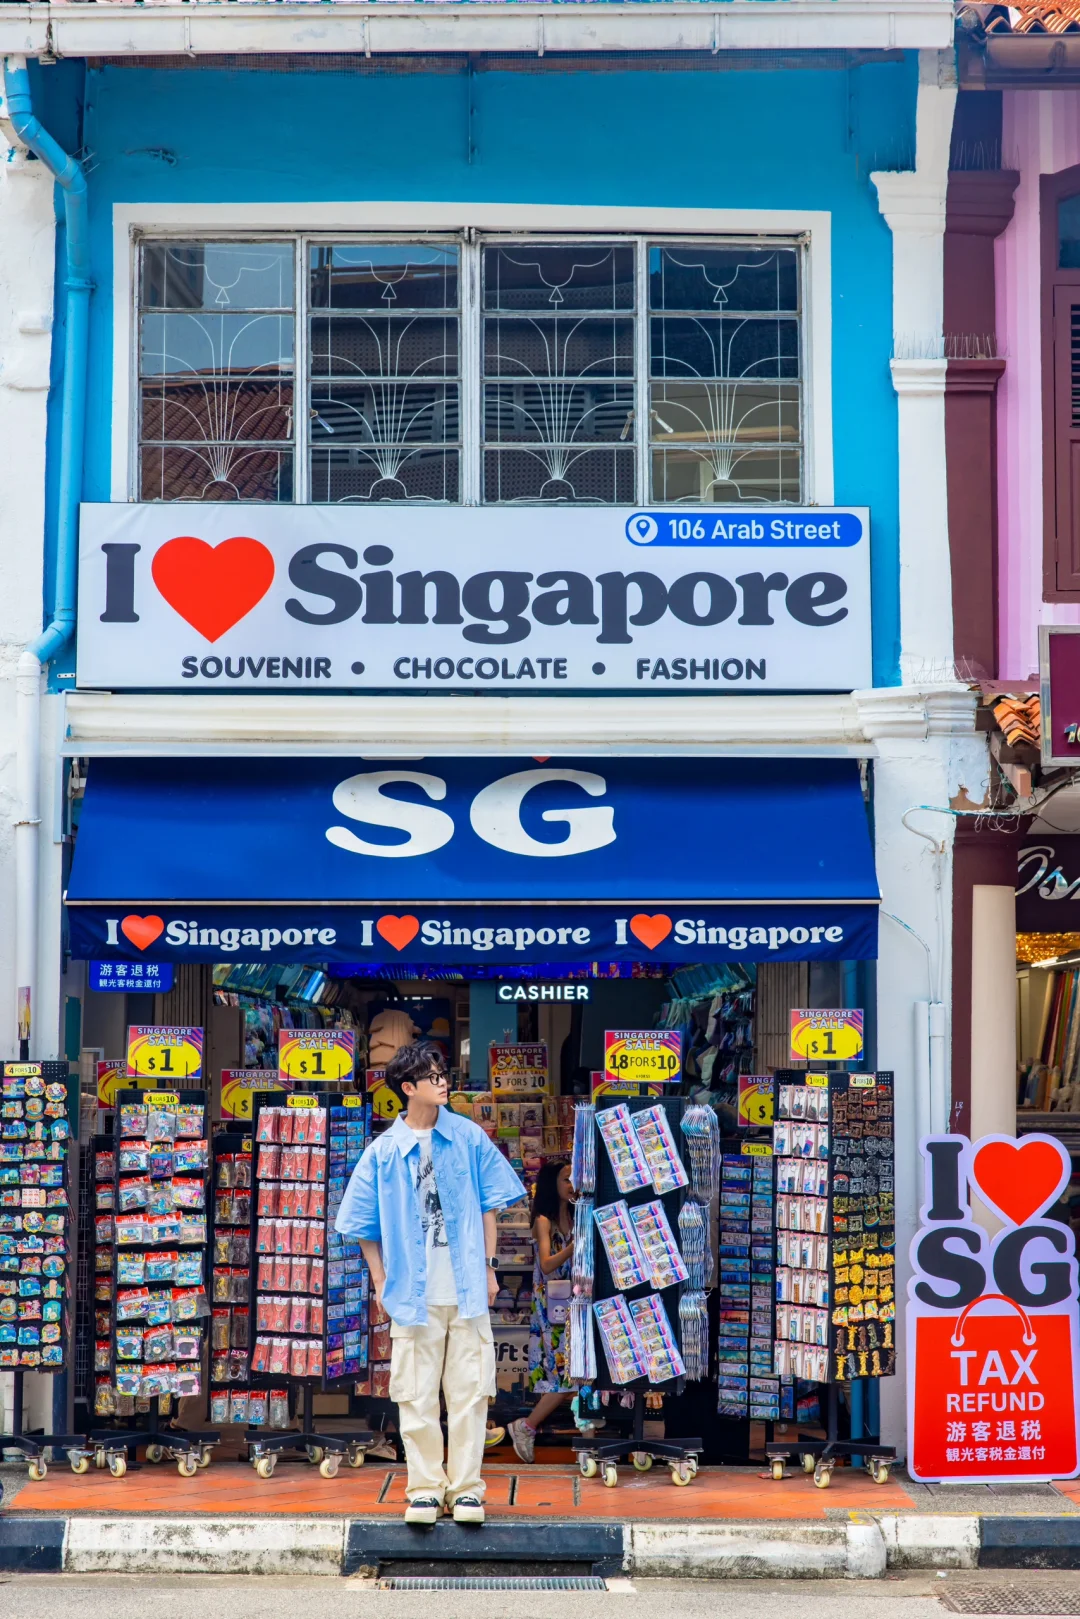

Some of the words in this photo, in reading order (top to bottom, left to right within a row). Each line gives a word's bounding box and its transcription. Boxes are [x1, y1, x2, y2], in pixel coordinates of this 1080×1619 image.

[668, 519, 705, 540] 106
[711, 519, 765, 541] Arab
[770, 519, 841, 541] Street
[99, 542, 141, 623] I
[284, 542, 849, 645] Singapore
[181, 655, 332, 679] SOUVENIR
[393, 656, 568, 680] CHOCOLATE
[636, 657, 766, 680] FASHION
[325, 768, 617, 858] SG
[106, 919, 120, 945] I
[165, 919, 336, 951] Singapore
[361, 919, 375, 946] I
[420, 919, 591, 951] Singapore
[615, 918, 628, 945] I
[673, 919, 844, 950] Singapore
[99, 963, 160, 977] 游客退税
[98, 978, 162, 989] 観光客税金還付
[499, 985, 590, 1001] CASHIER
[137, 1027, 192, 1035] SINGAPORE
[810, 1018, 845, 1029] SALE
[147, 1035, 183, 1046] SALE
[299, 1039, 335, 1050] SALE
[625, 1039, 661, 1050] SALE
[496, 1055, 543, 1070] SALE
[610, 1054, 629, 1069] 18
[630, 1056, 649, 1067] FOR
[9, 1066, 14, 1074] 4
[239, 1079, 275, 1089] SALE
[494, 1076, 502, 1088] 5
[757, 1084, 774, 1095] SA
[147, 1095, 153, 1103] 4
[926, 1141, 965, 1220] I
[914, 1225, 1073, 1309] SG
[495, 1342, 519, 1362] ift
[950, 1349, 1039, 1387] TAX
[946, 1391, 1045, 1413] REFUND
[946, 1420, 1042, 1443] 游客退税
[945, 1446, 1046, 1462] 観光客税金還付
